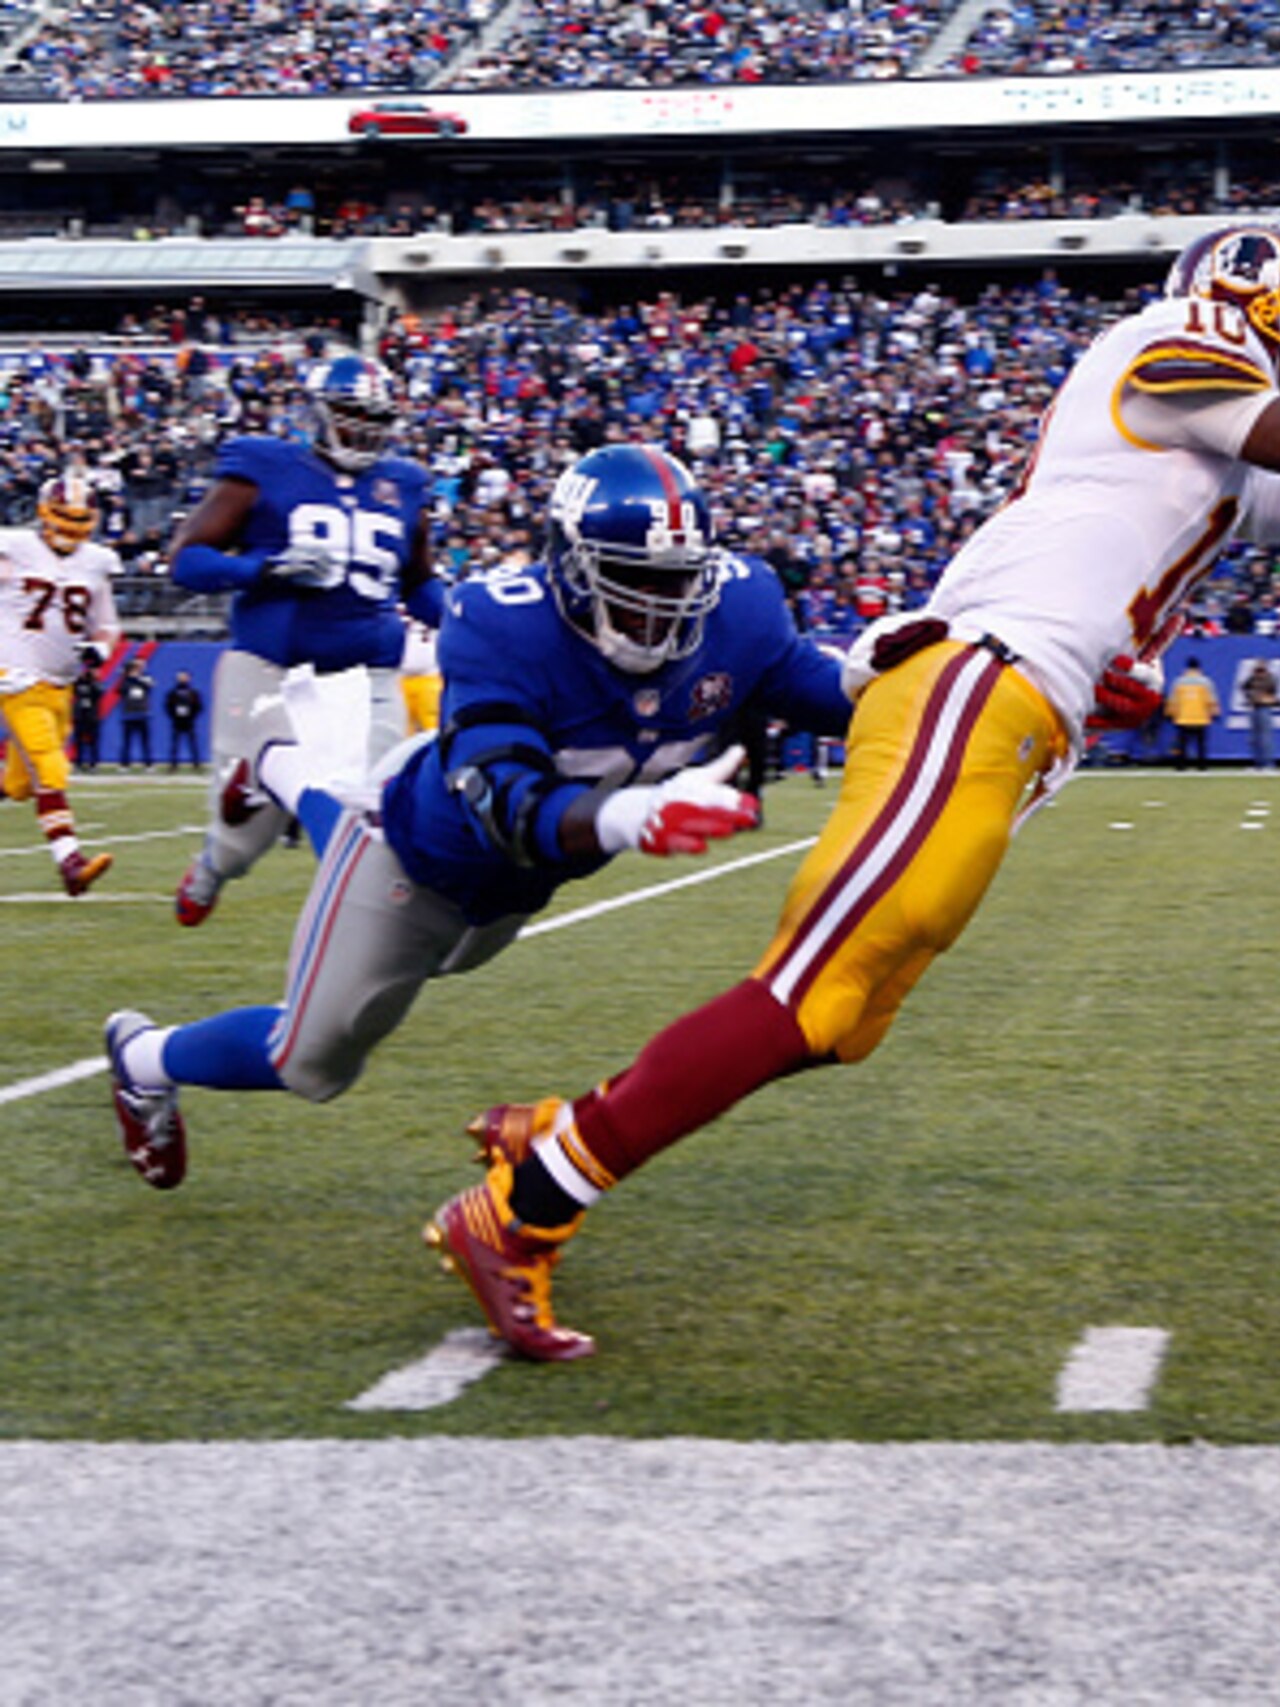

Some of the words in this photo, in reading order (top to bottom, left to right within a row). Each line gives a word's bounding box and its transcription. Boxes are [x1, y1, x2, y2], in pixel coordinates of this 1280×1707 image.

[1184, 301, 1246, 346] 10
[288, 503, 404, 600] 95
[21, 577, 91, 634] 78
